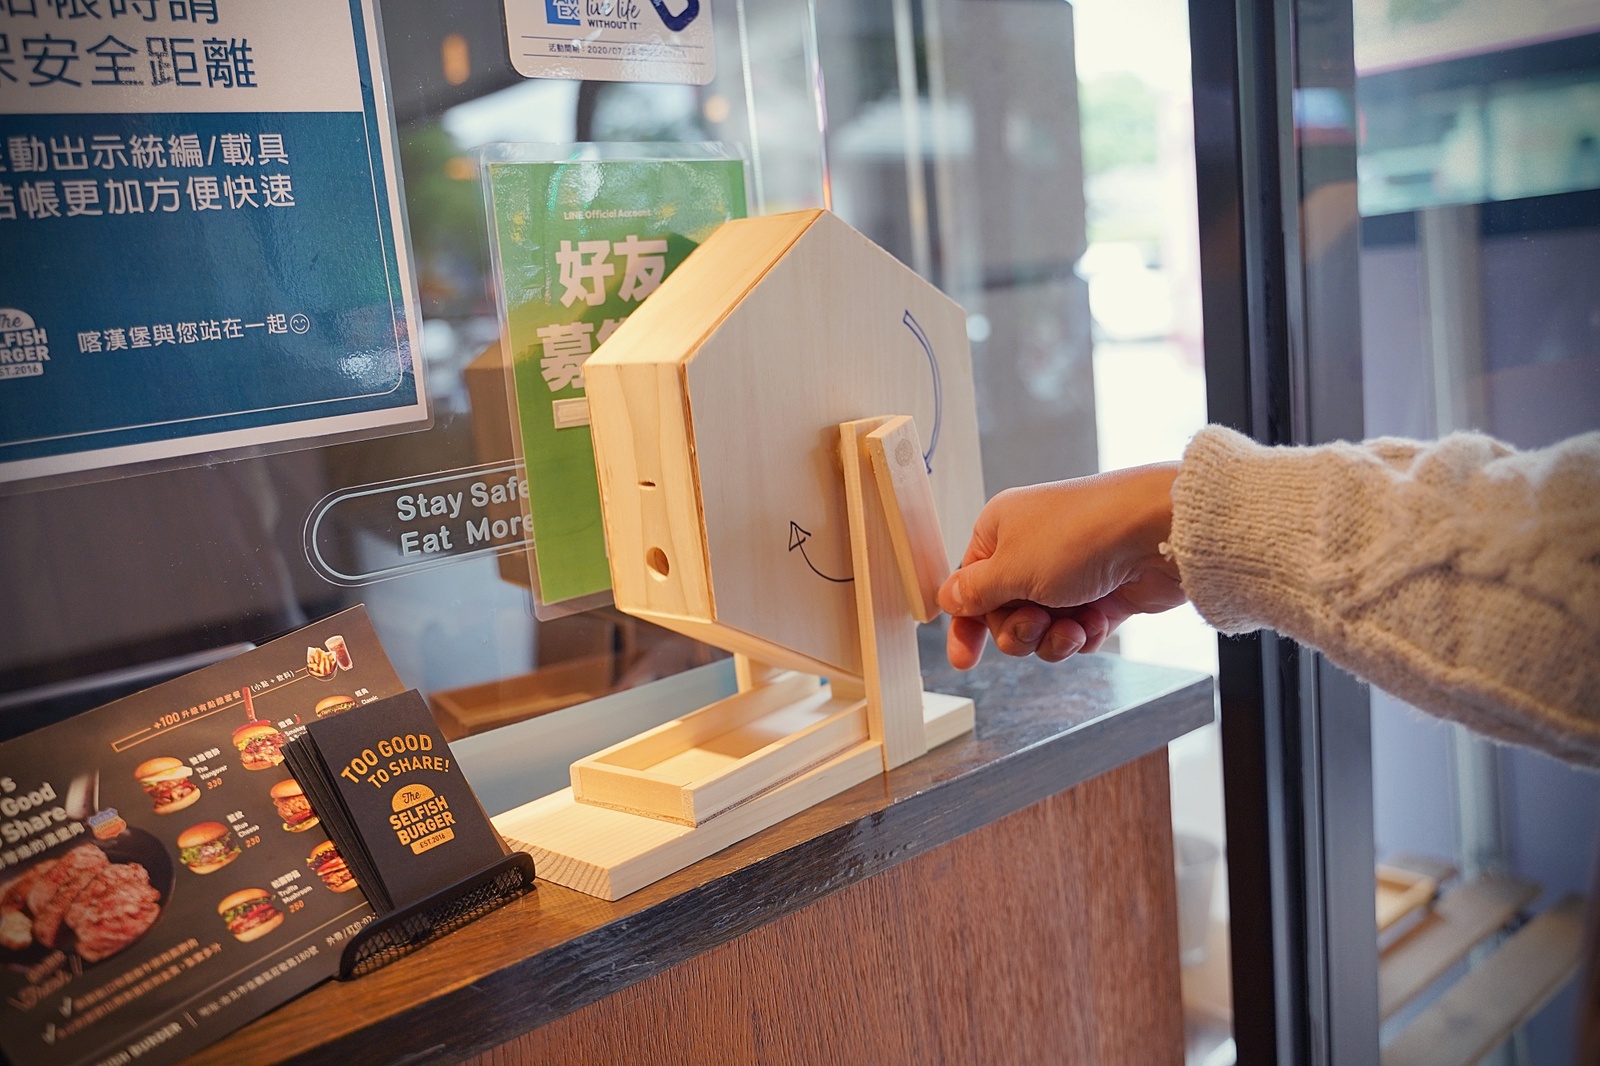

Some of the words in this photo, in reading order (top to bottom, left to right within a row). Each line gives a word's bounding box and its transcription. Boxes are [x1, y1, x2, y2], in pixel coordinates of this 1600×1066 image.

[587, 19, 627, 30] WITHOUT
[616, 0, 641, 21] life
[0, 133, 289, 174] 動出示統編/載具
[563, 211, 584, 220] LINE
[585, 209, 617, 219] Official
[617, 208, 650, 219] Account
[555, 235, 668, 308] 好友
[78, 313, 289, 354] 喀漢堡與您站在一起
[396, 491, 463, 522] Stay
[470, 475, 530, 508] Safe
[400, 525, 453, 557] Eat
[465, 513, 534, 545] More
[361, 695, 379, 705] Classic
[153, 711, 181, 730] +100
[340, 748, 379, 784] TOO
[377, 734, 433, 758] GOOD
[367, 768, 390, 789] TO
[388, 755, 450, 777] SHARE!
[1, 781, 57, 818] Good
[207, 777, 222, 790] 330
[402, 790, 421, 804] The
[1, 806, 68, 844] Share
[388, 795, 450, 830] SELFISH
[396, 811, 456, 846] BURGER
[245, 835, 260, 848] 230
[420, 833, 446, 848] EST.2016
